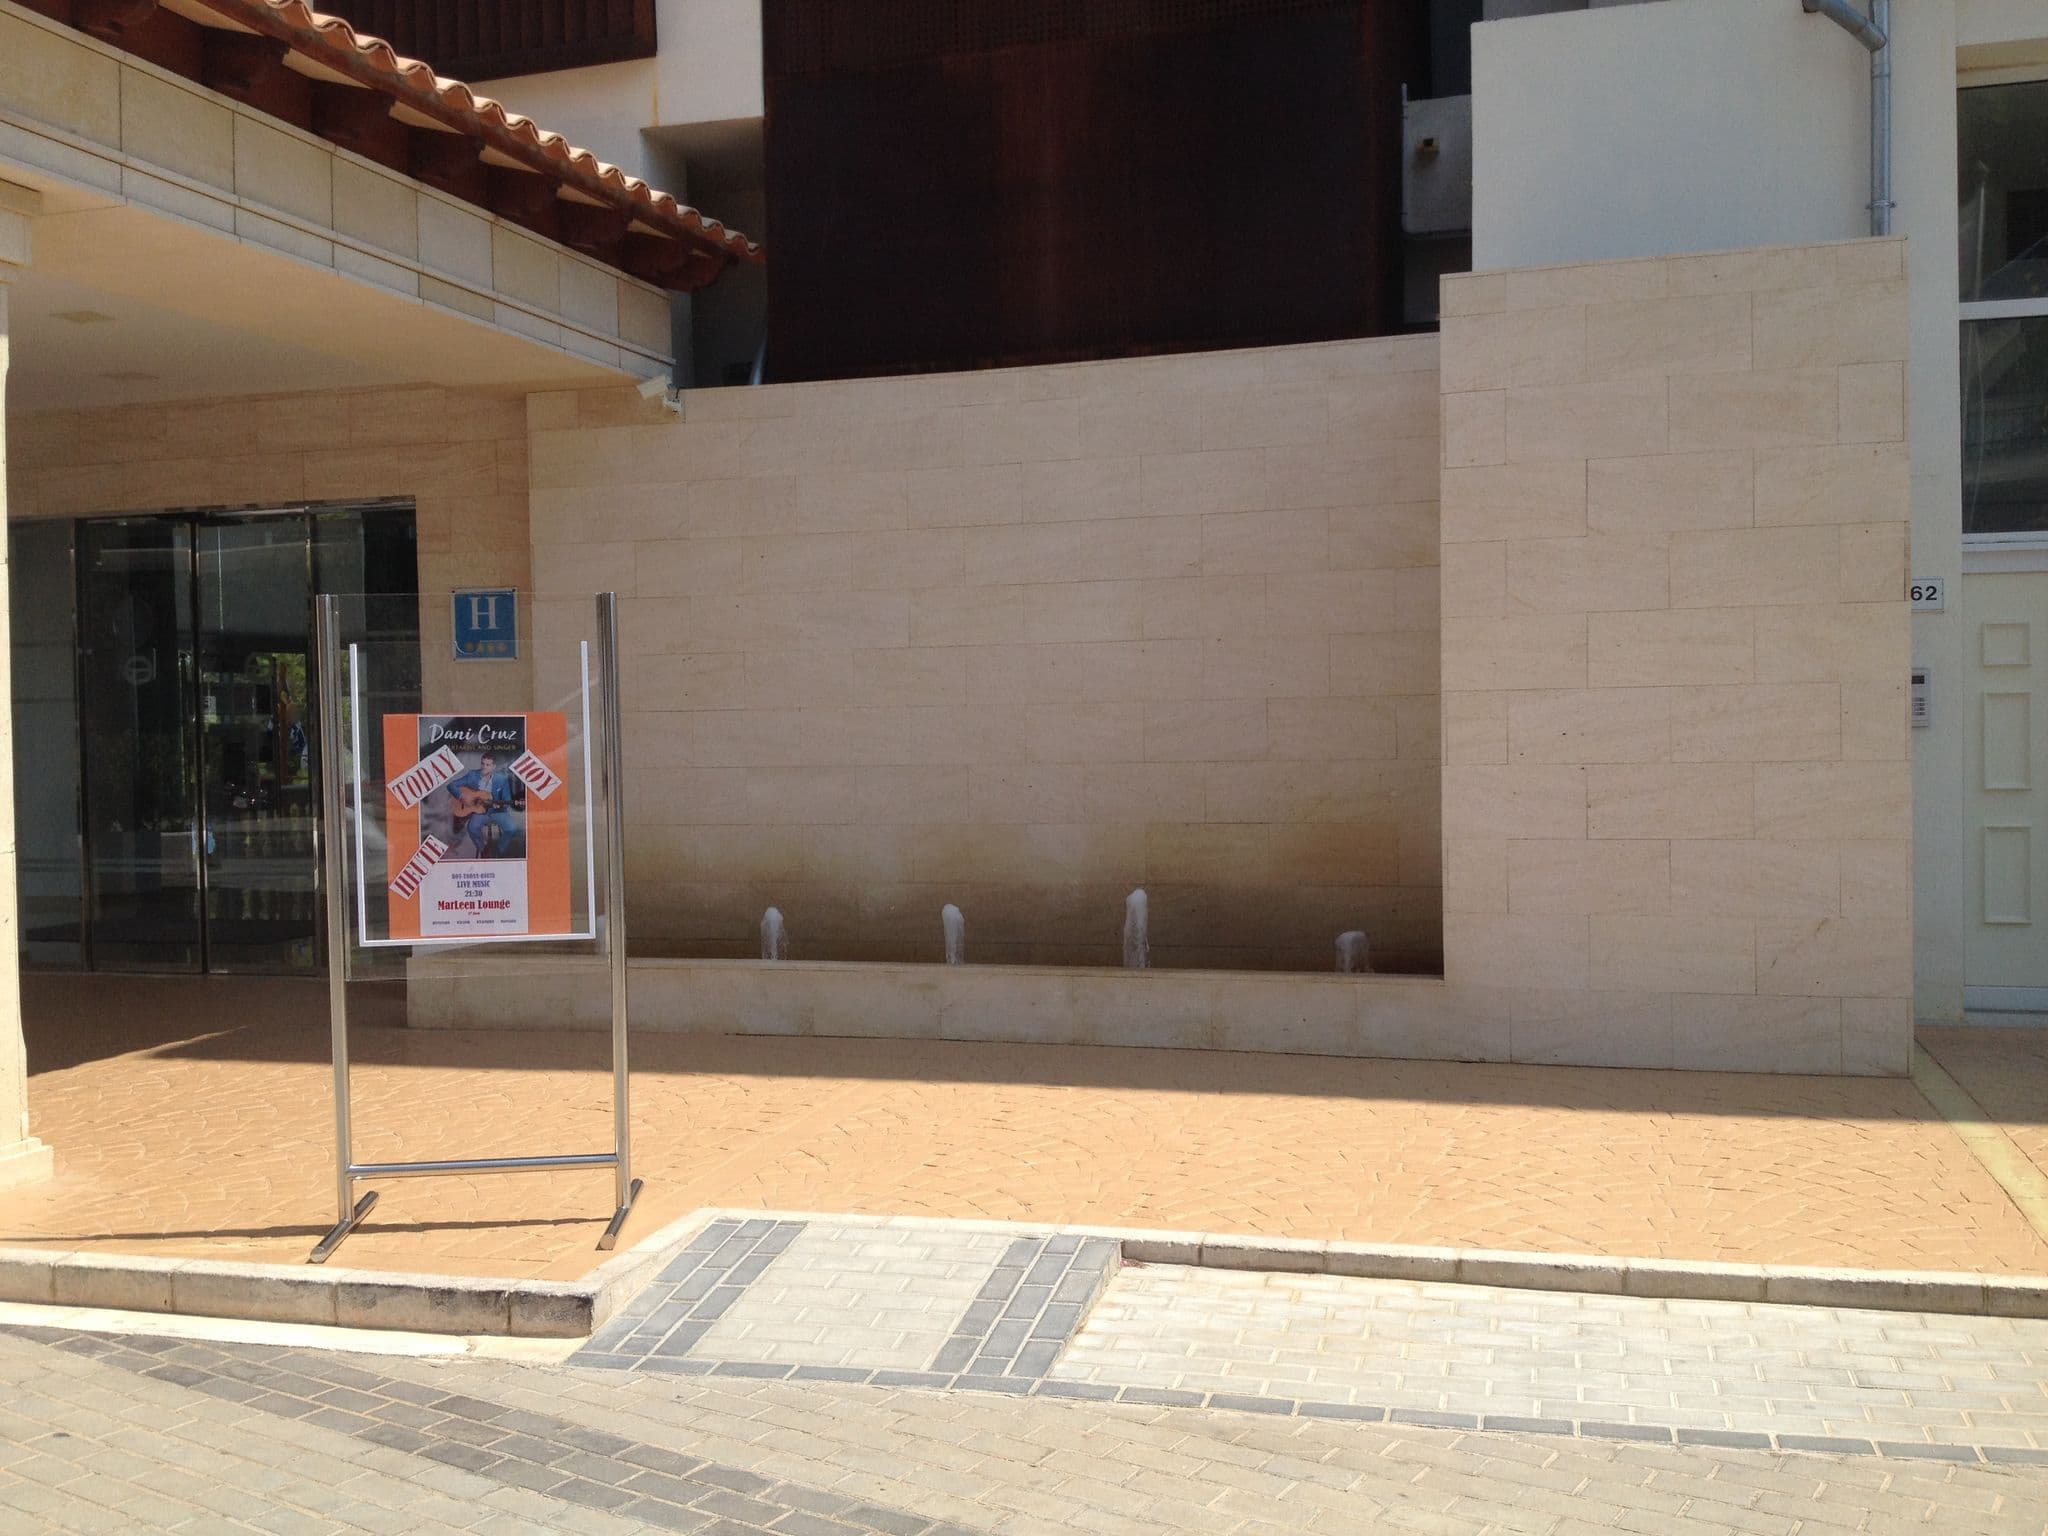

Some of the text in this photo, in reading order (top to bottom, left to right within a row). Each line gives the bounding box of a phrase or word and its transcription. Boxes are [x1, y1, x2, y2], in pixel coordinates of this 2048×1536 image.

[1910, 585, 1938, 601] 62
[468, 596, 501, 630] H
[429, 723, 519, 744] Dani Cruz
[392, 747, 457, 806] TODAY
[513, 754, 558, 793] HOY
[394, 836, 445, 897] HEUTE
[456, 879, 491, 888] LIVE MUSIC
[464, 889, 483, 898] 21:30
[477, 898, 511, 910] Lounge
